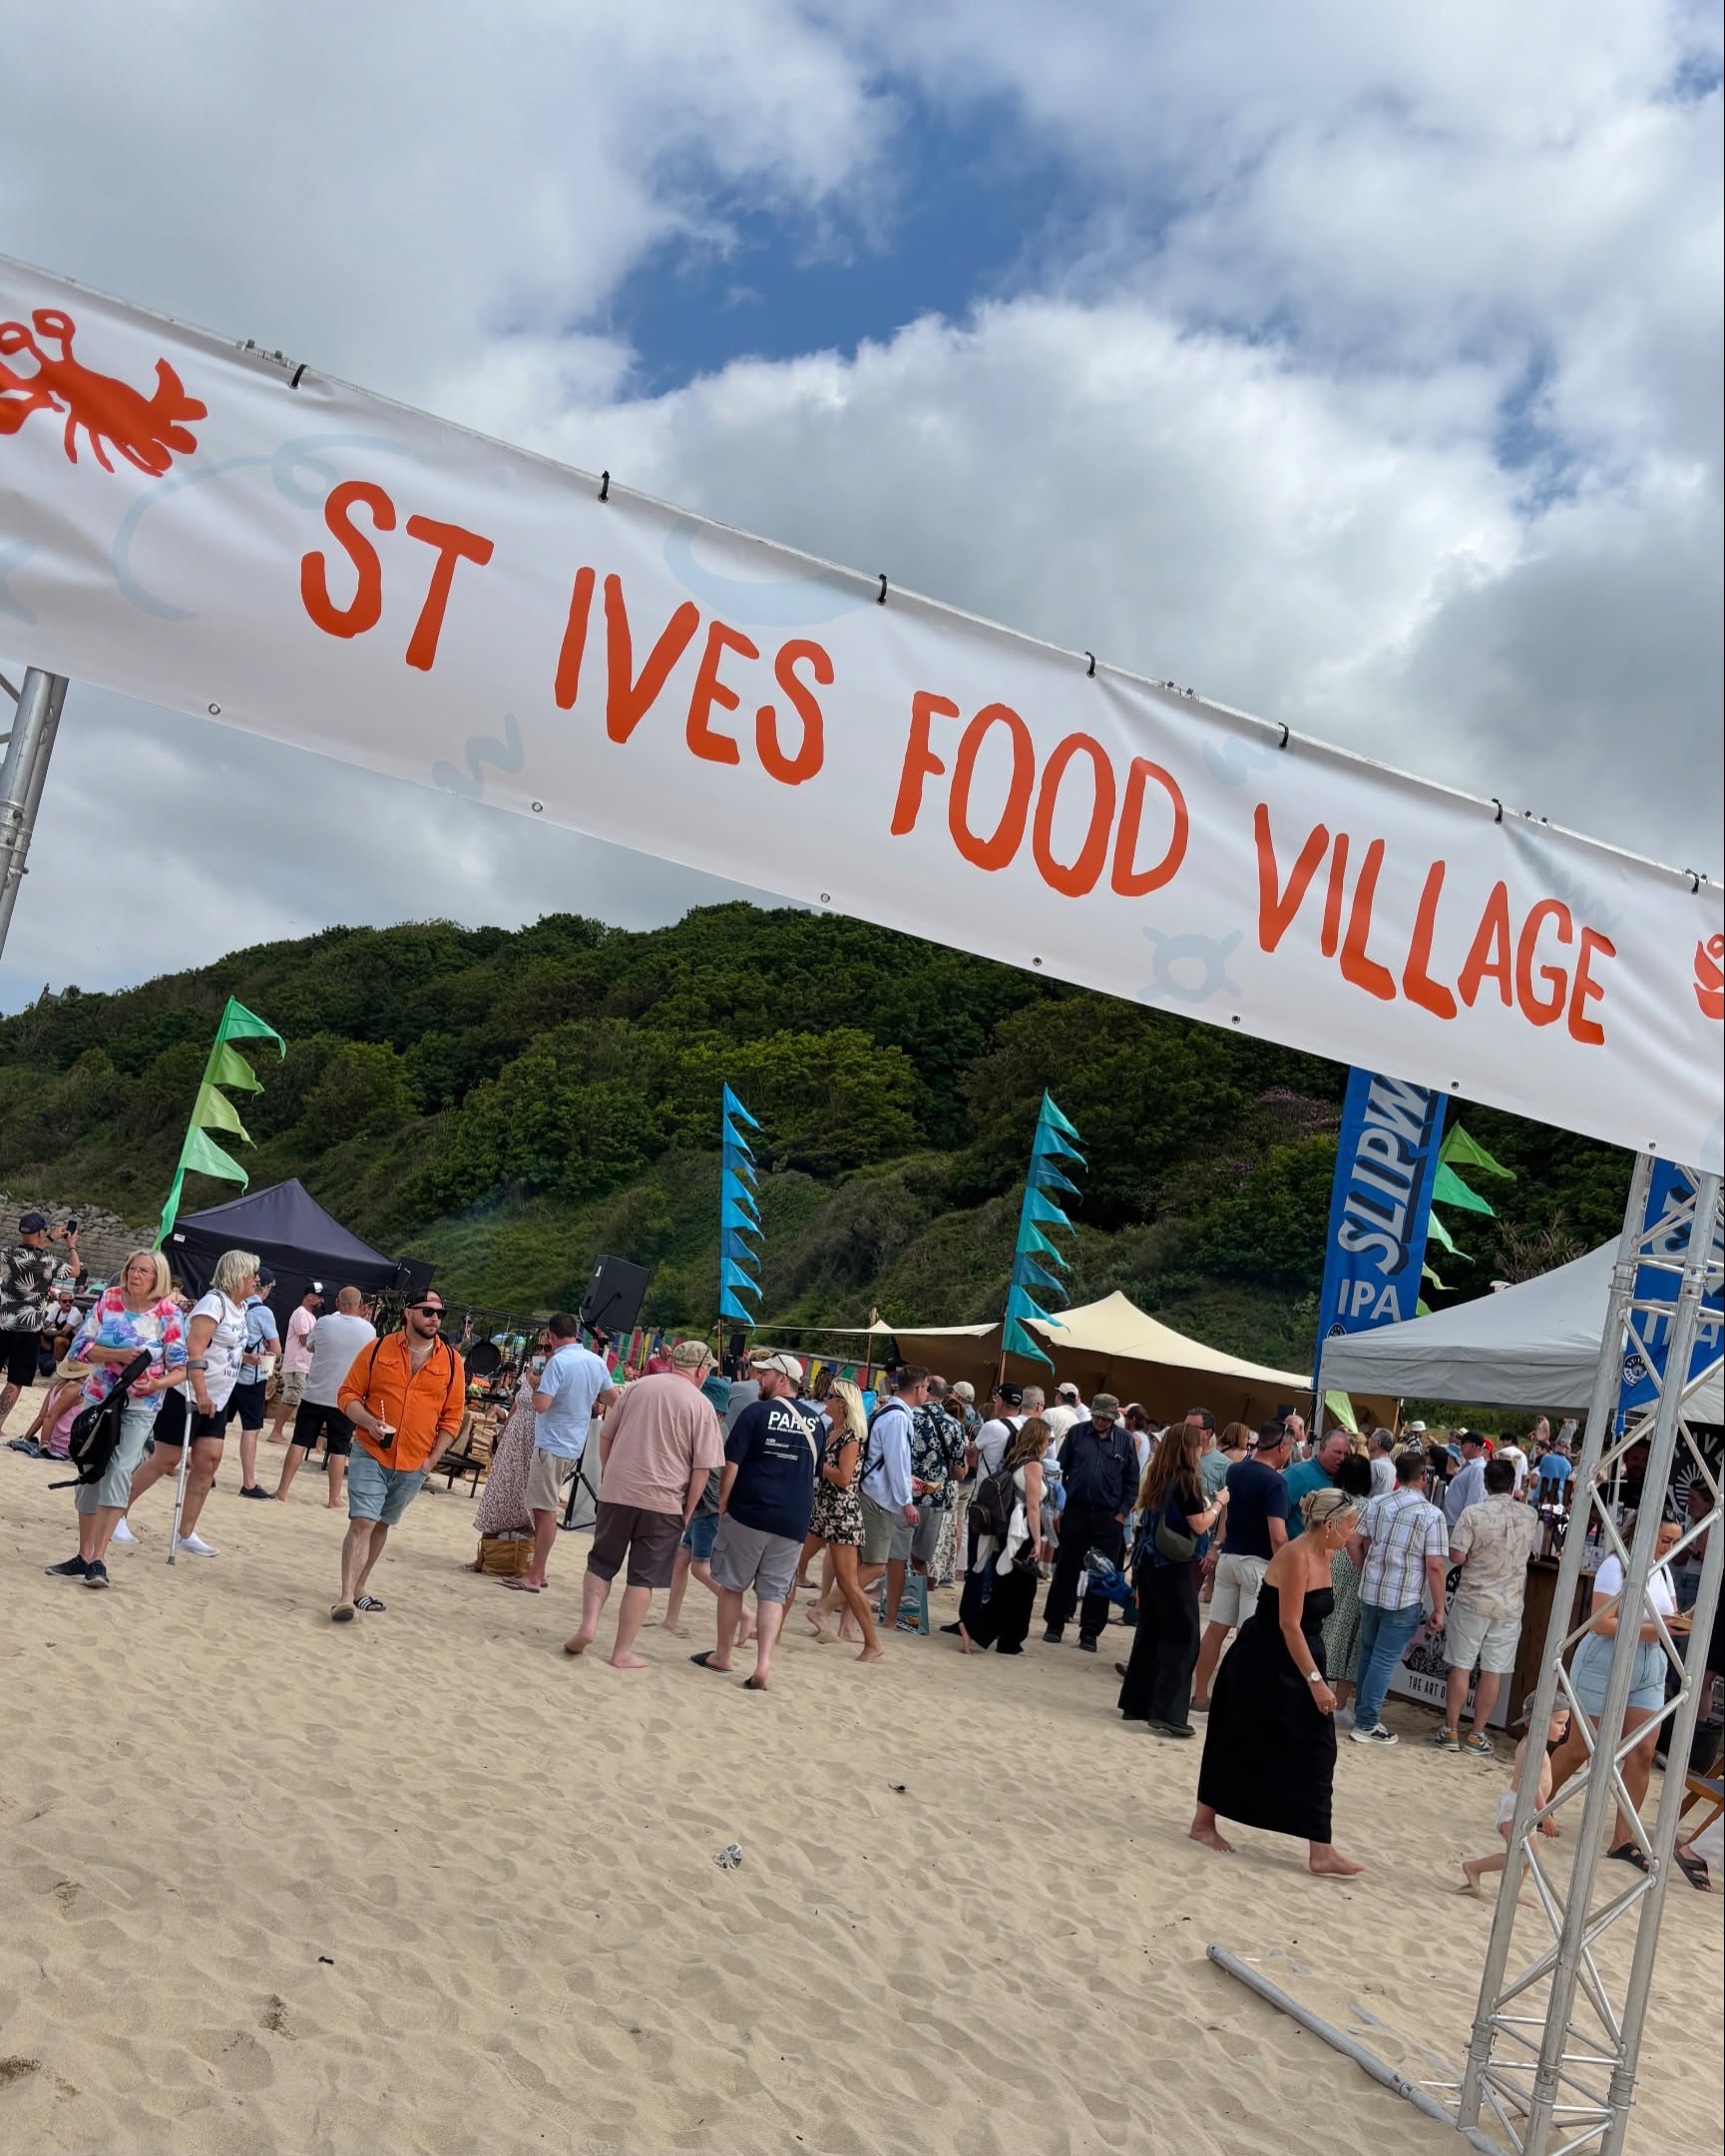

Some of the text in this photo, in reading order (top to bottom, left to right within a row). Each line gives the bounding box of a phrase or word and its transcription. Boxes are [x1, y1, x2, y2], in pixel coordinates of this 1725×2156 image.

[301, 482, 1615, 1045] ST IVES FOOD VILLAGE
[1338, 1075, 1433, 1276] SLIPW
[1337, 1278, 1402, 1322] IPA
[1642, 1298, 1720, 1350] IA
[1408, 1675, 1422, 1692] THE
[1424, 1680, 1439, 1697] ART
